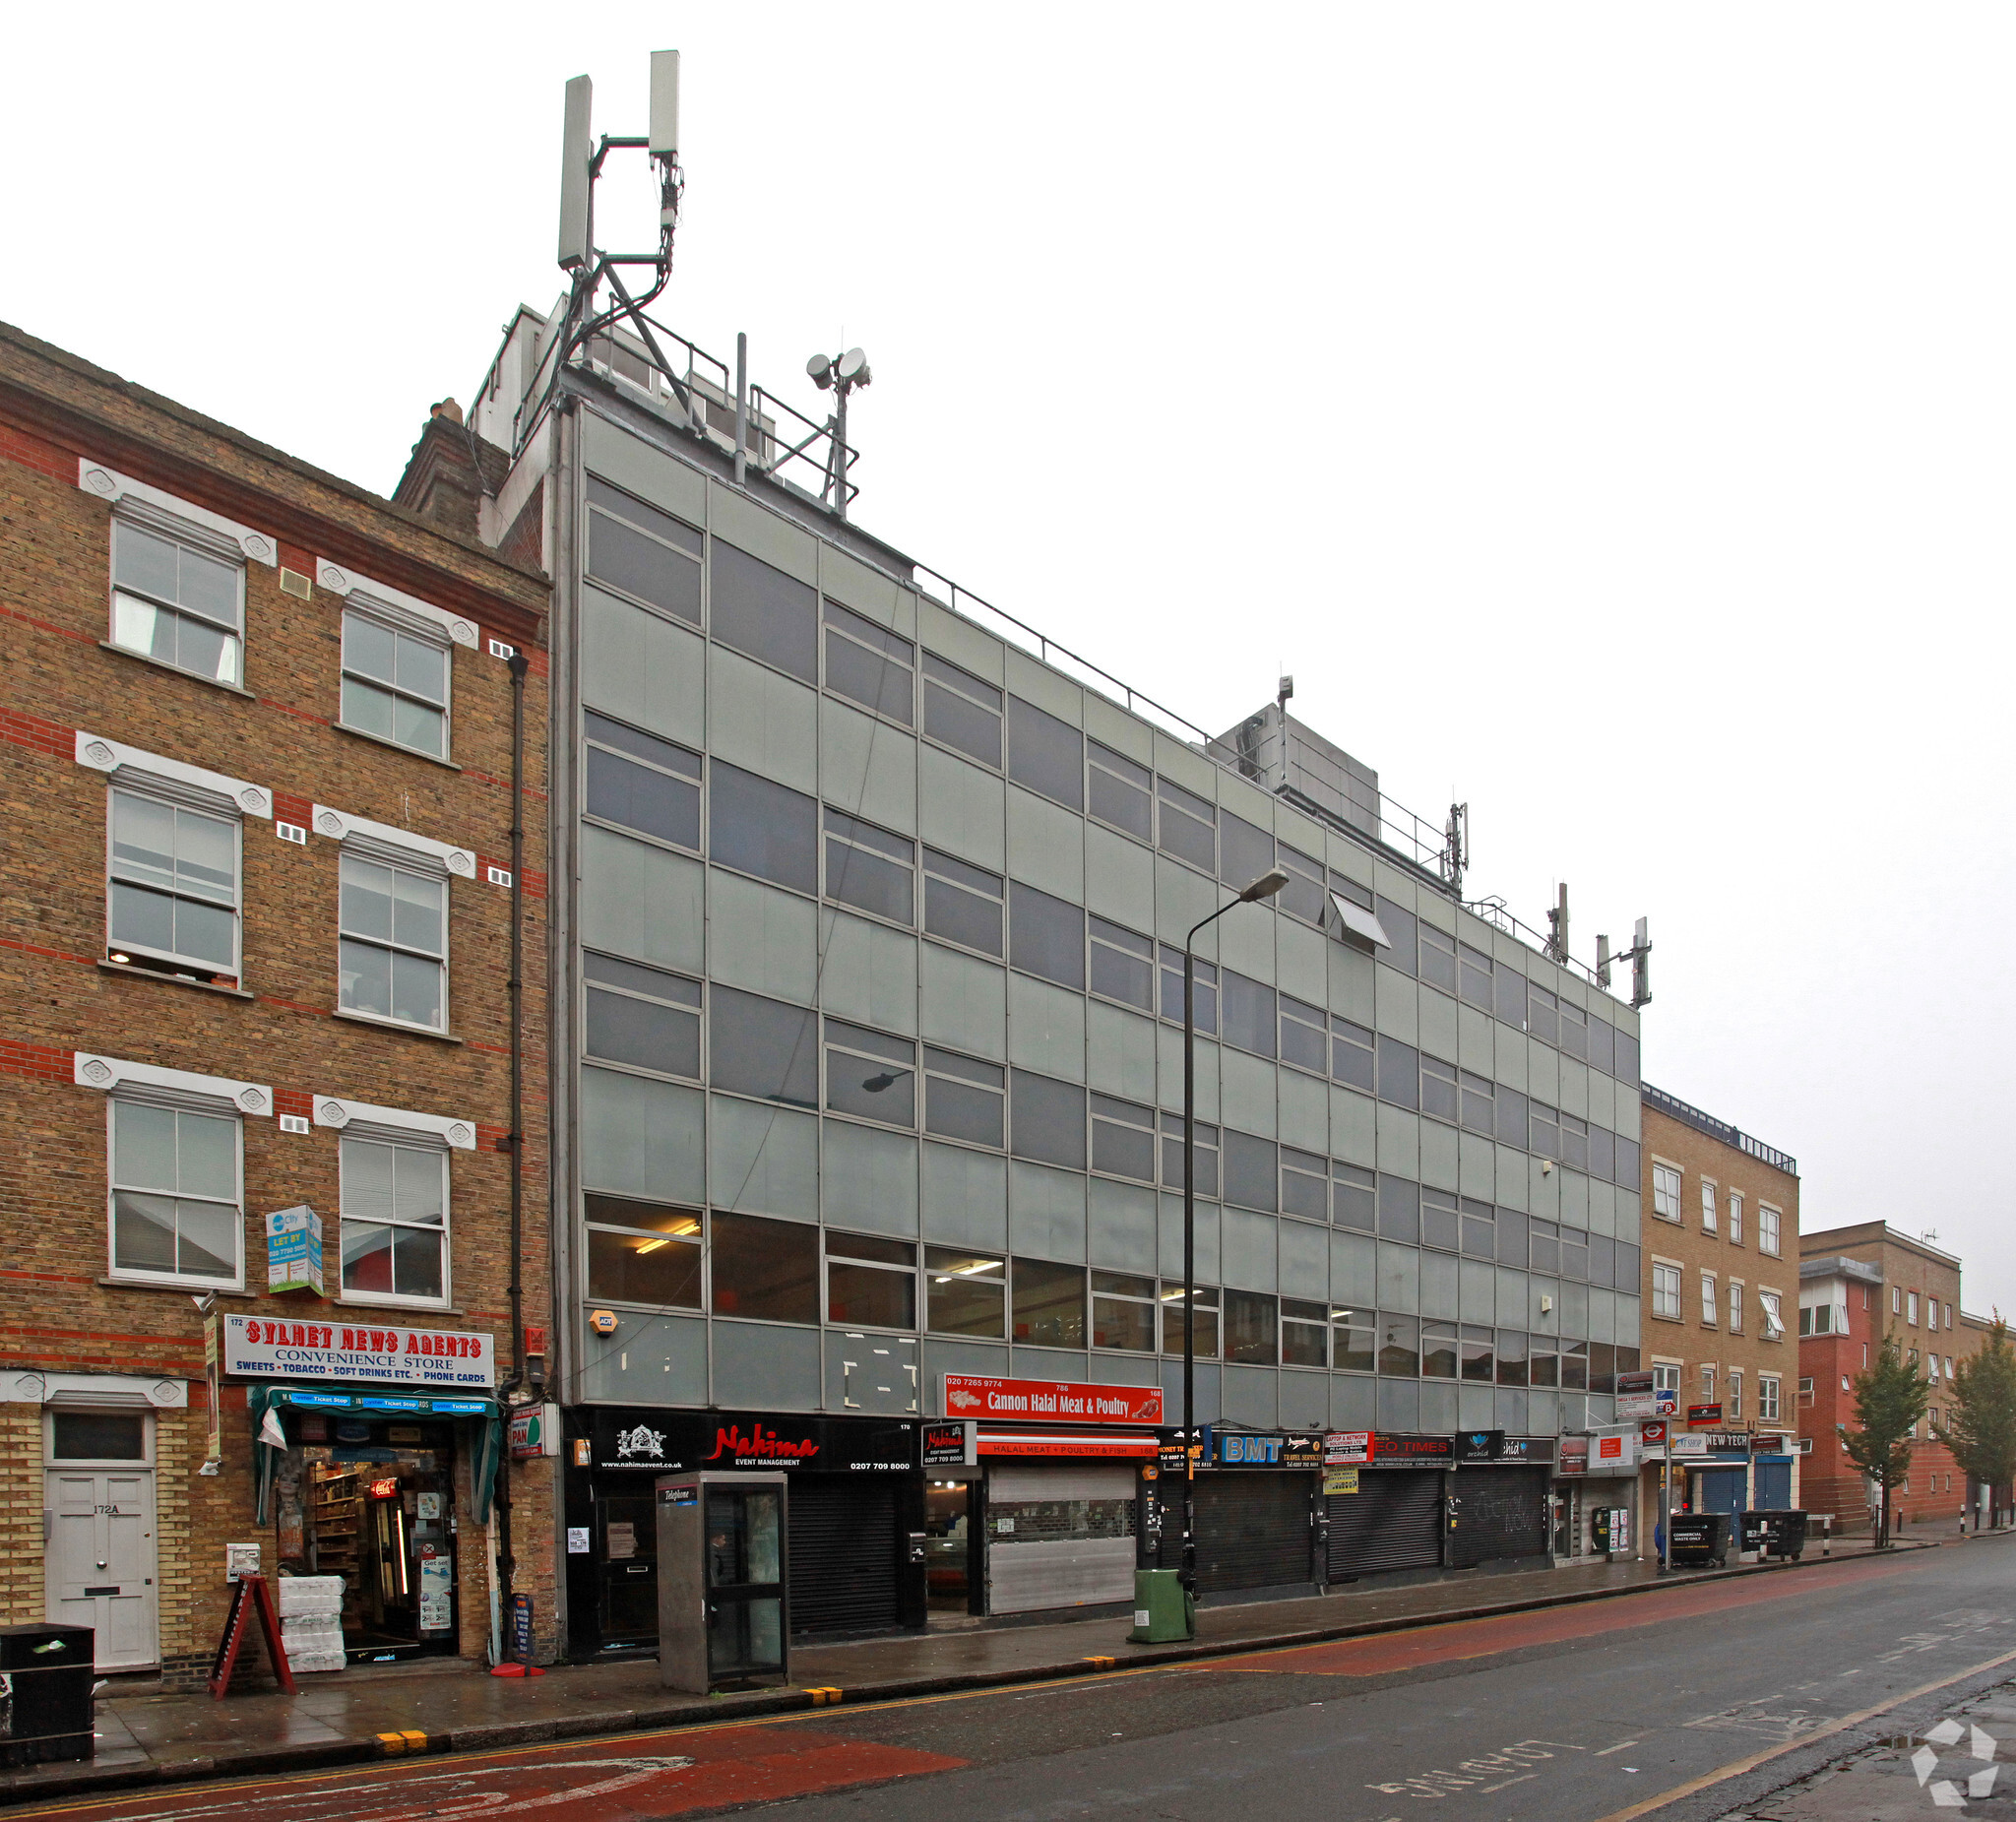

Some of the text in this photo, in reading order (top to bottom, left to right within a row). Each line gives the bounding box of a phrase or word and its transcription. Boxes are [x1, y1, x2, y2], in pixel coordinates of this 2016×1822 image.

[274, 1233, 300, 1246] LET BY
[245, 1320, 332, 1349] SYLHET
[340, 1328, 399, 1352] NEWS
[405, 1333, 481, 1358] AGENTS
[276, 1350, 453, 1369] CONVENIENCE STORE
[236, 1360, 275, 1371] SWEETS
[283, 1364, 326, 1373] TOBACCO
[334, 1366, 356, 1375] SOFT
[359, 1368, 392, 1378] DRINKS
[395, 1370, 412, 1379] ETC.
[424, 1372, 454, 1381] PHONE
[987, 1392, 1129, 1417] Cannon Halal Meat & Poultry
[1666, 1404, 1672, 1413] B
[513, 1429, 527, 1444] PAN
[702, 1423, 820, 1460] Nahima
[925, 1429, 964, 1450] Nahima
[1706, 1434, 1747, 1446] NEW TECH
[1222, 1437, 1284, 1463] BMT
[1403, 1442, 1448, 1452] TIMES
[665, 1489, 689, 1501] Telephone
[94, 1505, 119, 1514] 172A
